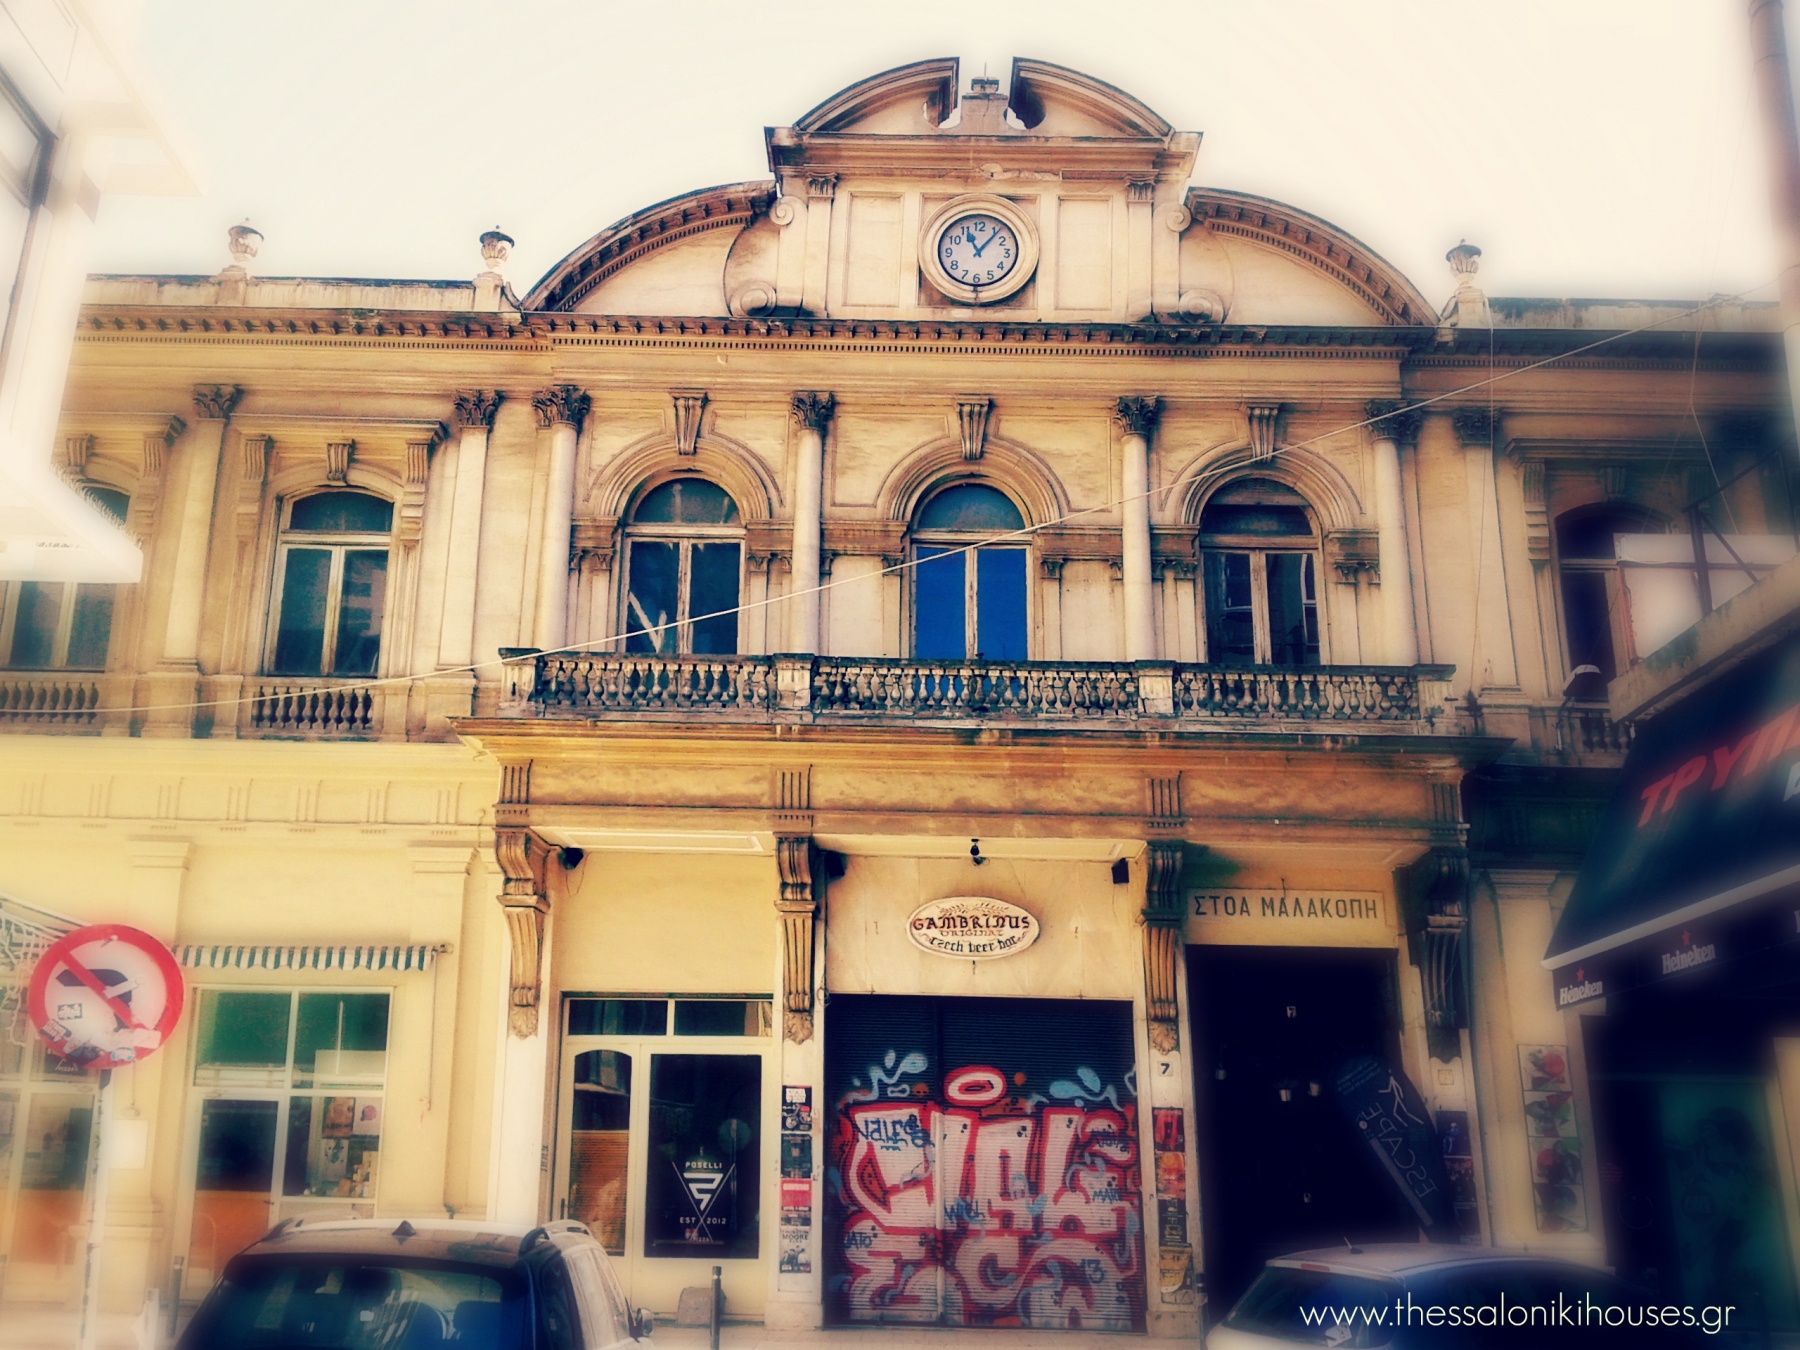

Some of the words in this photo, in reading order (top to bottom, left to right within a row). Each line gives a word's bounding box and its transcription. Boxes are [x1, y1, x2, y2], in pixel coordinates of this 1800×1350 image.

[960, 226, 971, 236] 11
[973, 221, 986, 232] 12
[949, 235, 961, 245] 10
[999, 236, 1006, 246] 2
[945, 247, 953, 258] 9
[1003, 248, 1011, 258] 3
[950, 260, 959, 270] 8
[996, 261, 1005, 271] 4
[961, 270, 969, 280] 7
[972, 273, 980, 283] 6
[986, 270, 994, 280] 5
[1194, 895, 1251, 917] ΣΤΟΑ
[1261, 896, 1378, 919] ΜΑΛΑΚΟΠΗ
[912, 914, 1030, 931] GAMBRINUS
[930, 936, 964, 953] czech
[968, 941, 995, 953] beer
[997, 935, 1016, 950] bar
[1661, 943, 1716, 975] Heineken
[1559, 980, 1603, 1006] Heineken
[1160, 1062, 1171, 1075] 7
[685, 1161, 722, 1169] POSELLI
[680, 1216, 697, 1224] EST
[706, 1217, 727, 1225] 2012
